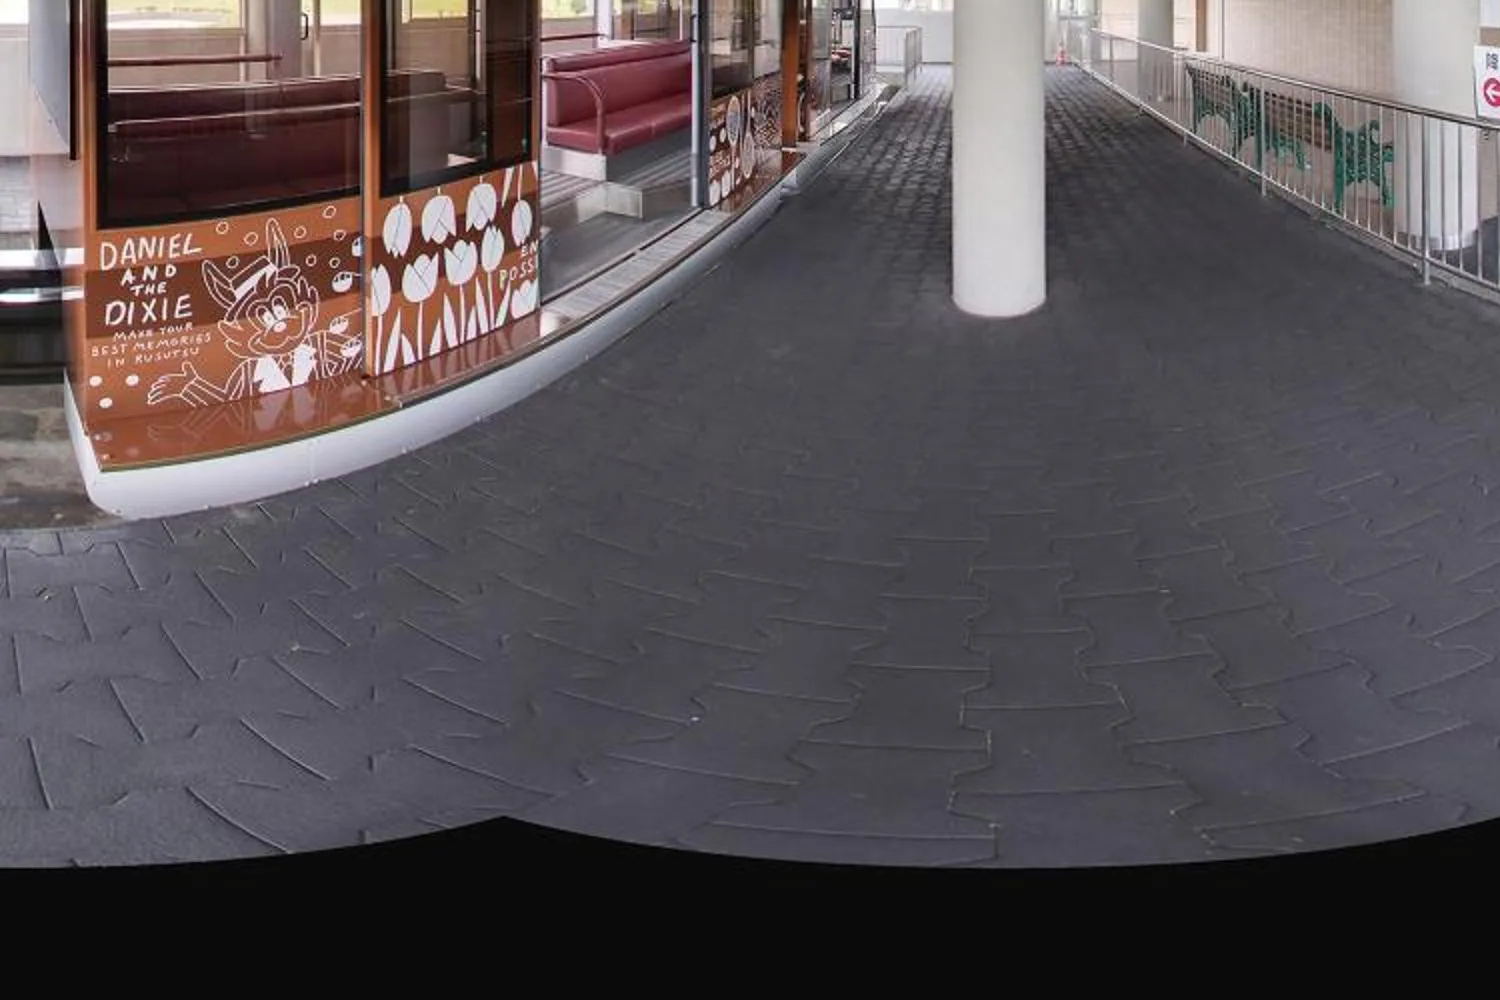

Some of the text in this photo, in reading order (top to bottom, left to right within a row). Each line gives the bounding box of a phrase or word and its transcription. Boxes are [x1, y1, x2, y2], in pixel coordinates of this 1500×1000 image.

[100, 233, 202, 271] DANIEL
[121, 264, 177, 286] AND
[130, 281, 167, 297] THE
[105, 294, 193, 326] DIXIE
[113, 321, 194, 342] MAKE YOUR
[91, 331, 212, 357] BEST MEMORIES
[107, 346, 201, 369] IN RUSUTSU
